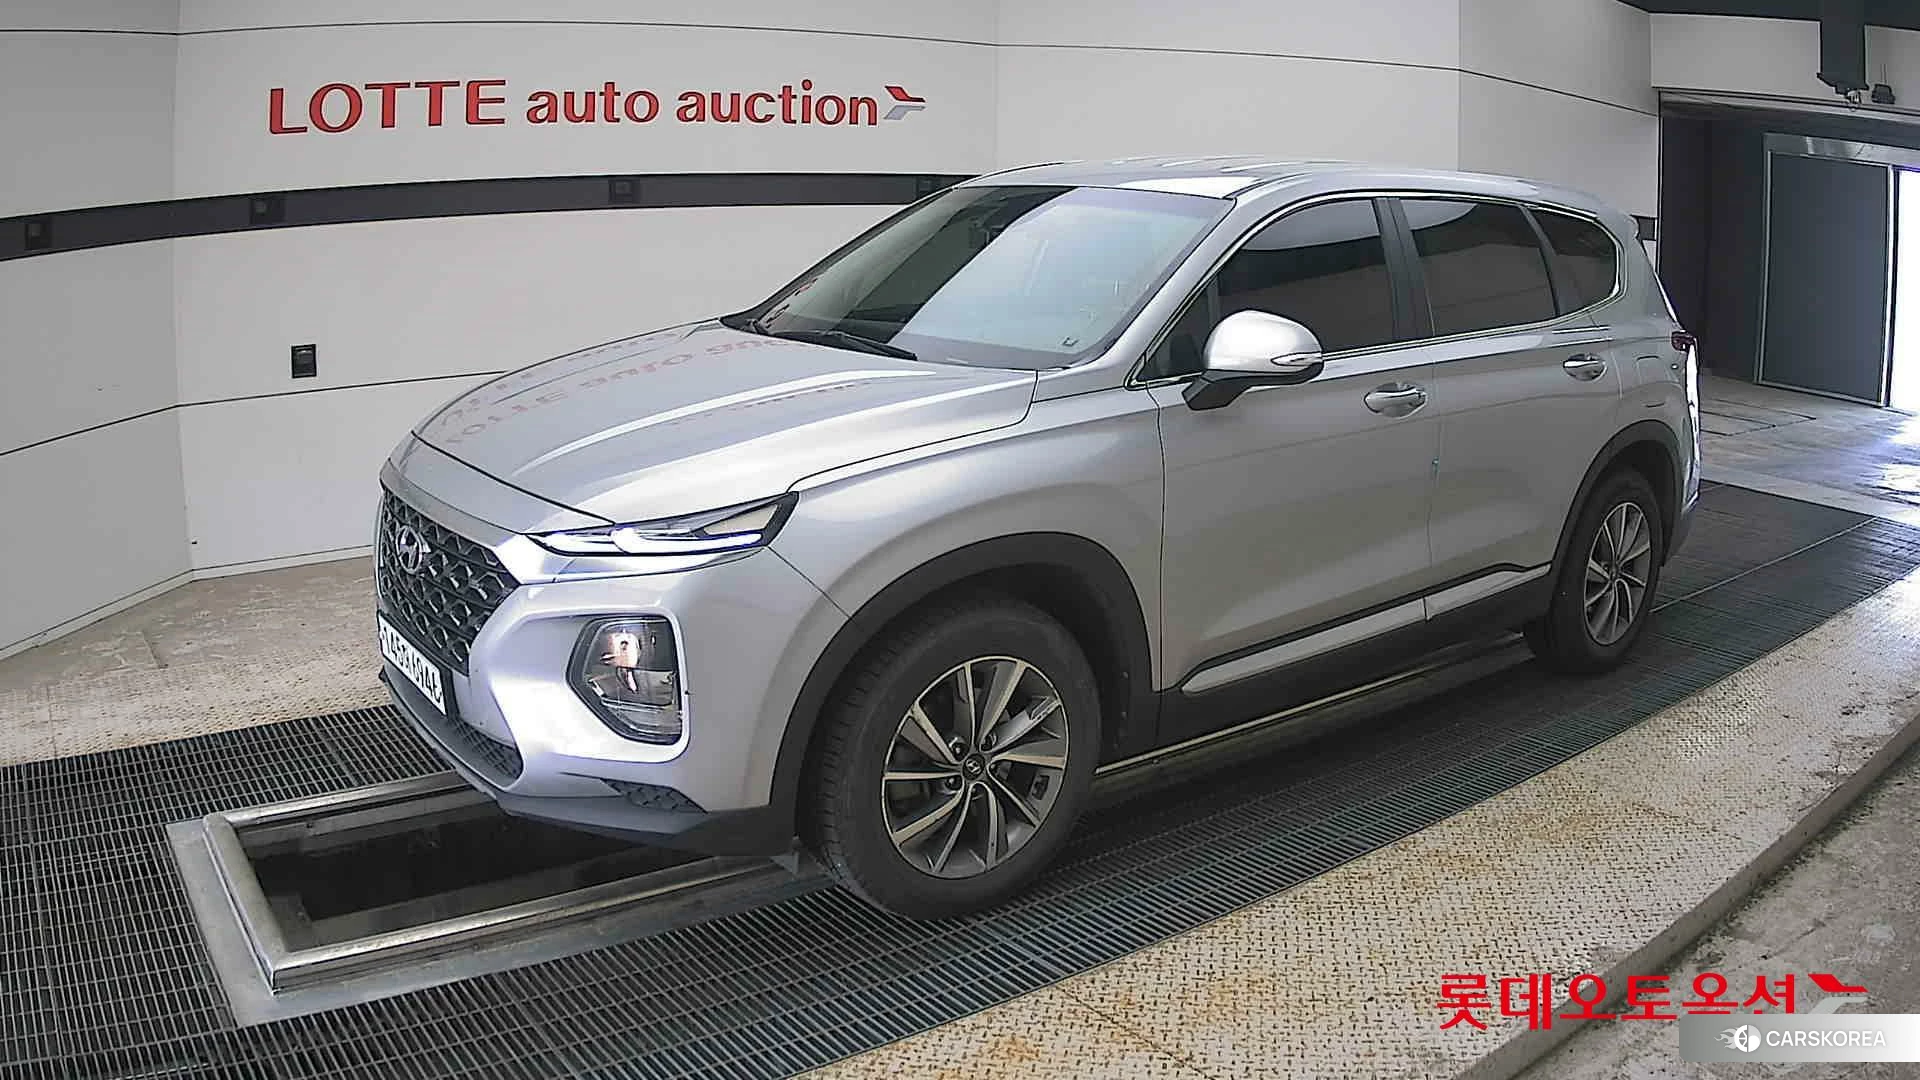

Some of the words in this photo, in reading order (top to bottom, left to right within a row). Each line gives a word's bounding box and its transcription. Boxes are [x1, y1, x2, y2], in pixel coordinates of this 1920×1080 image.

[269, 79, 506, 135] LOTTE
[526, 81, 660, 124] auto
[676, 79, 878, 126] auction
